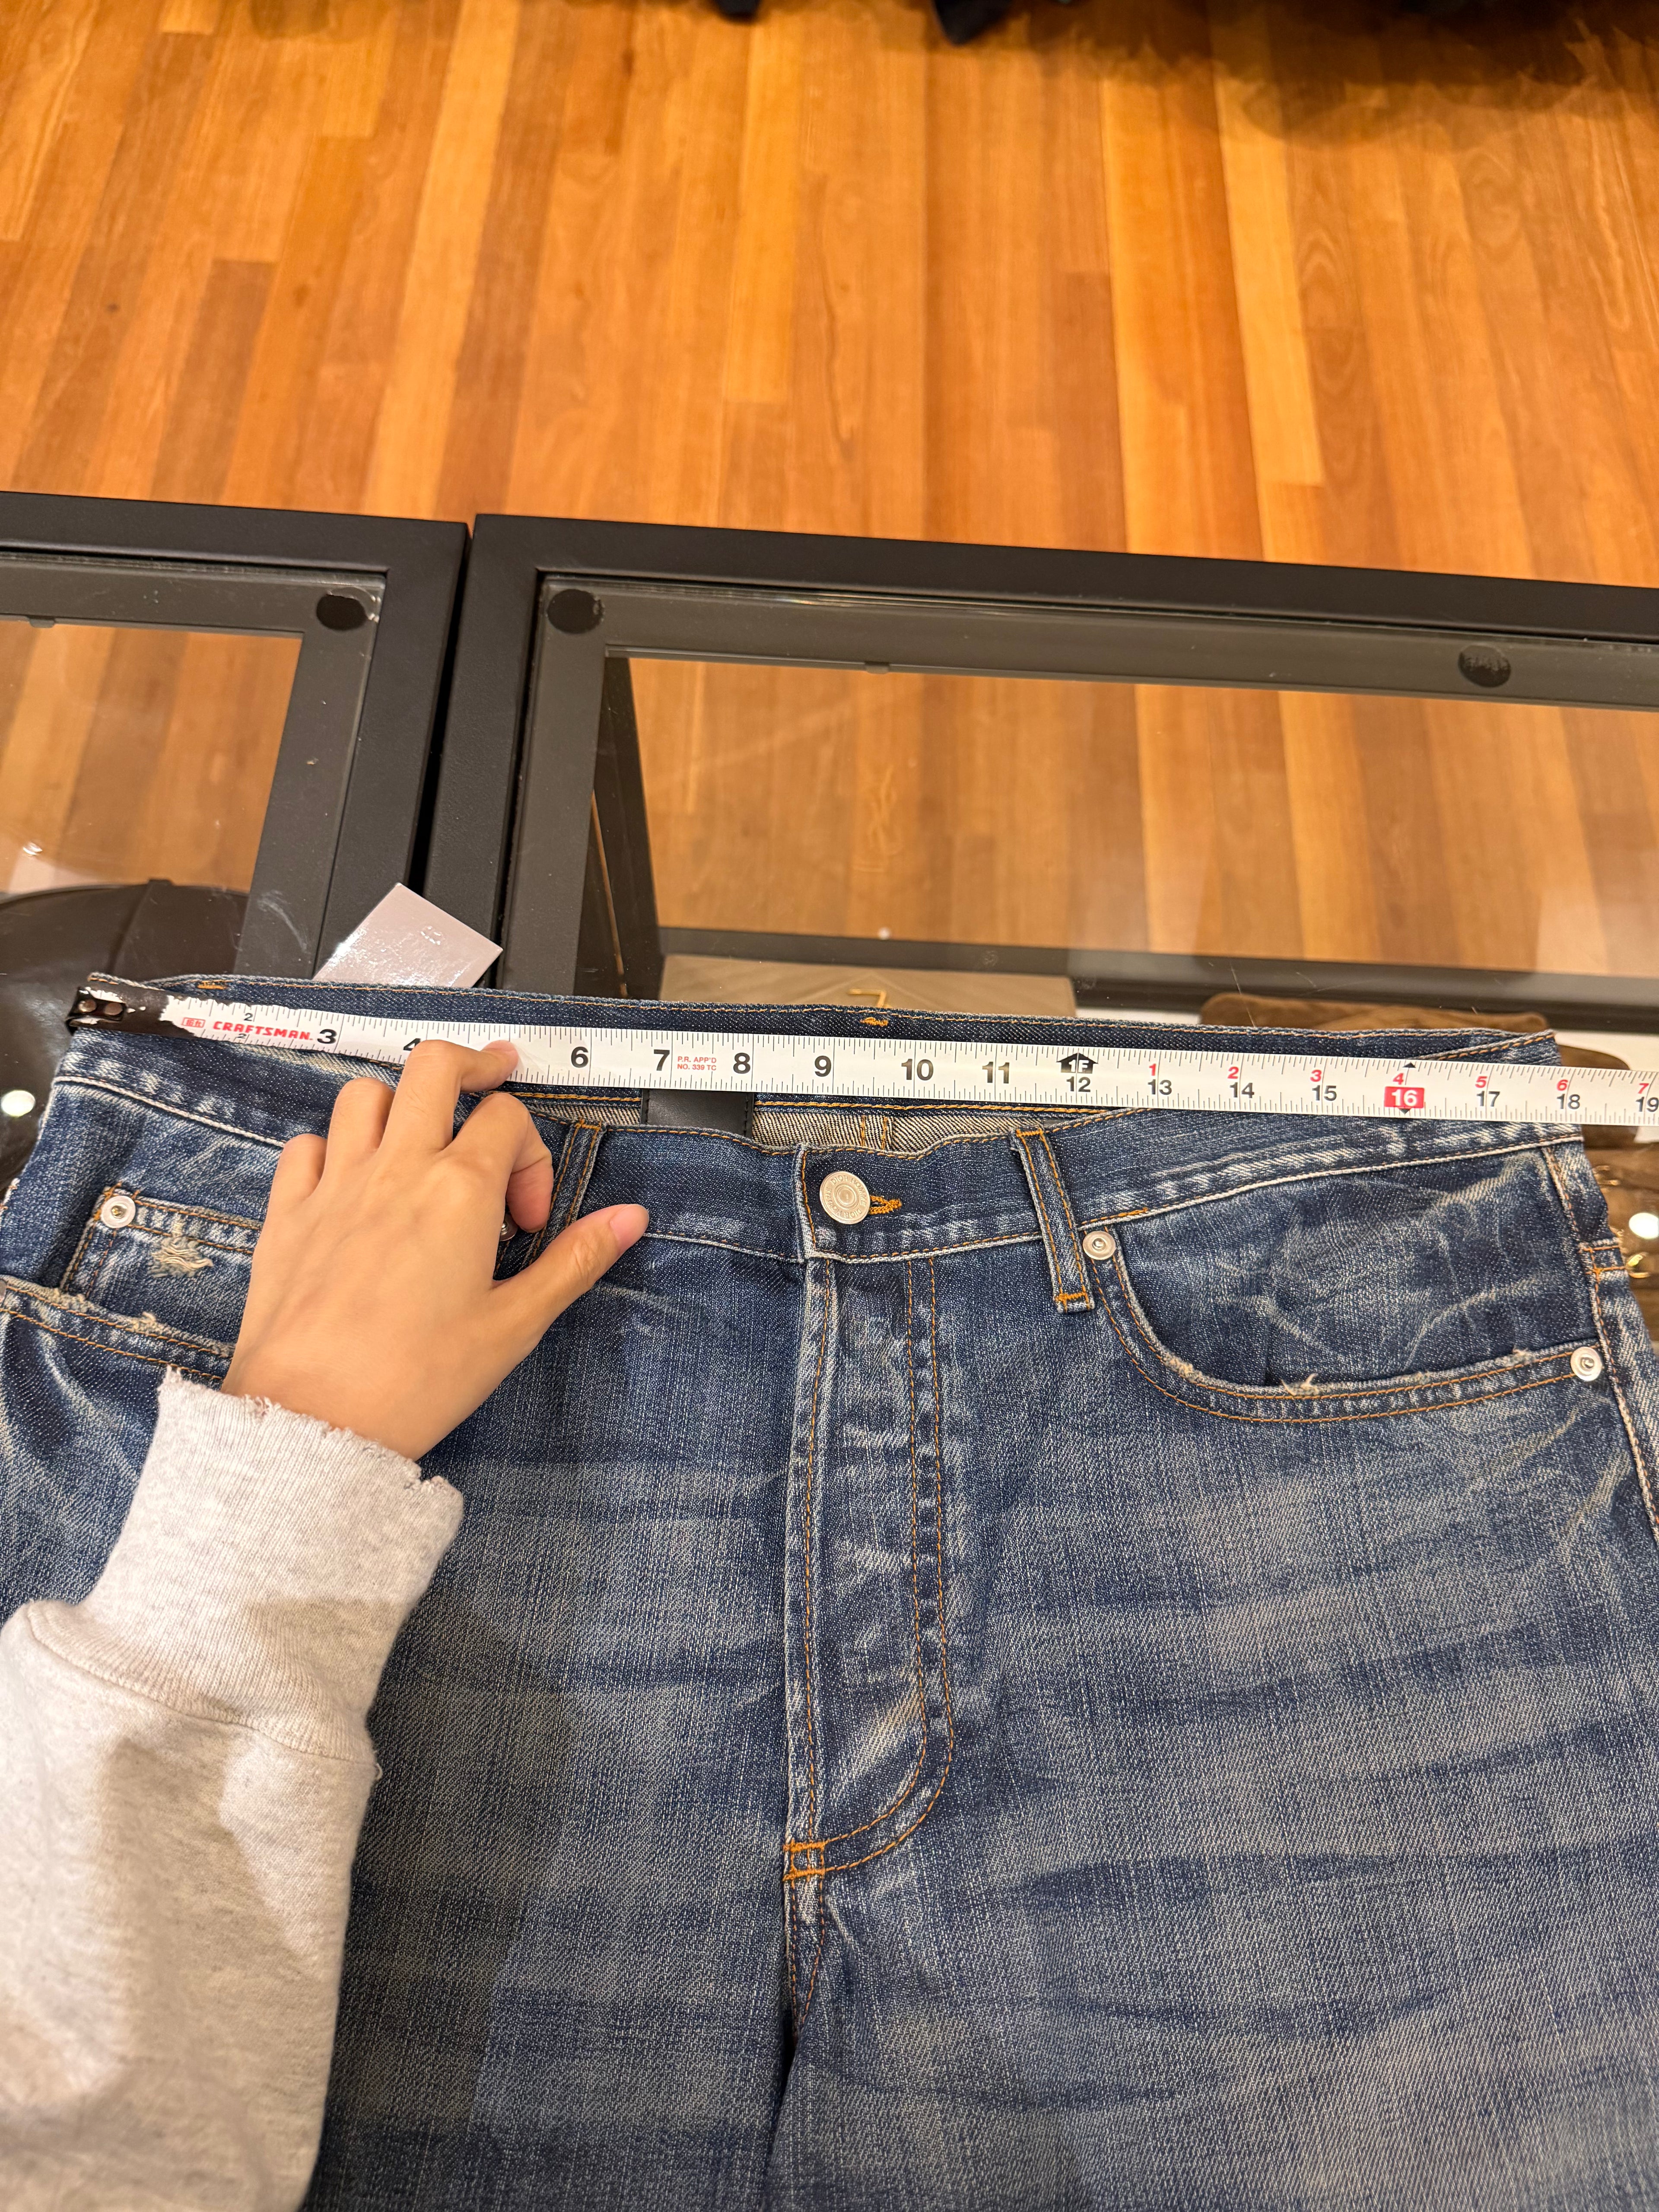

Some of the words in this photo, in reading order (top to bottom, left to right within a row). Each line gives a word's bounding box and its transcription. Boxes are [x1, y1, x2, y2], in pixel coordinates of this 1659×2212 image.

[244, 1013, 254, 1021] 2
[317, 1029, 337, 1044] 3
[403, 1038, 421, 1051] 4
[571, 1046, 589, 1068] 6
[653, 1049, 670, 1071] 7
[733, 1052, 751, 1074] 8
[814, 1055, 832, 1077] 9
[901, 1058, 934, 1081] 10
[982, 1061, 1010, 1084] 11
[1148, 1063, 1157, 1076] 1
[1227, 1066, 1239, 1079] 2
[1310, 1070, 1322, 1082] 3
[1392, 1073, 1404, 1085] 4
[1475, 1076, 1487, 1088] 5
[1066, 1076, 1091, 1093] 12
[1147, 1079, 1173, 1095] 13
[1230, 1082, 1255, 1098] 14
[1556, 1079, 1568, 1091] 6
[1637, 1083, 1649, 1094] 7
[1311, 1085, 1337, 1101] 15
[1391, 1090, 1417, 1106] 16
[1476, 1090, 1500, 1107] 17
[1557, 1093, 1581, 1109] 18
[1636, 1096, 1659, 1112] 19
[830, 1175, 849, 1185] DIOR
[850, 1178, 867, 1207] HOMME
[844, 1208, 862, 1218] DIOR
